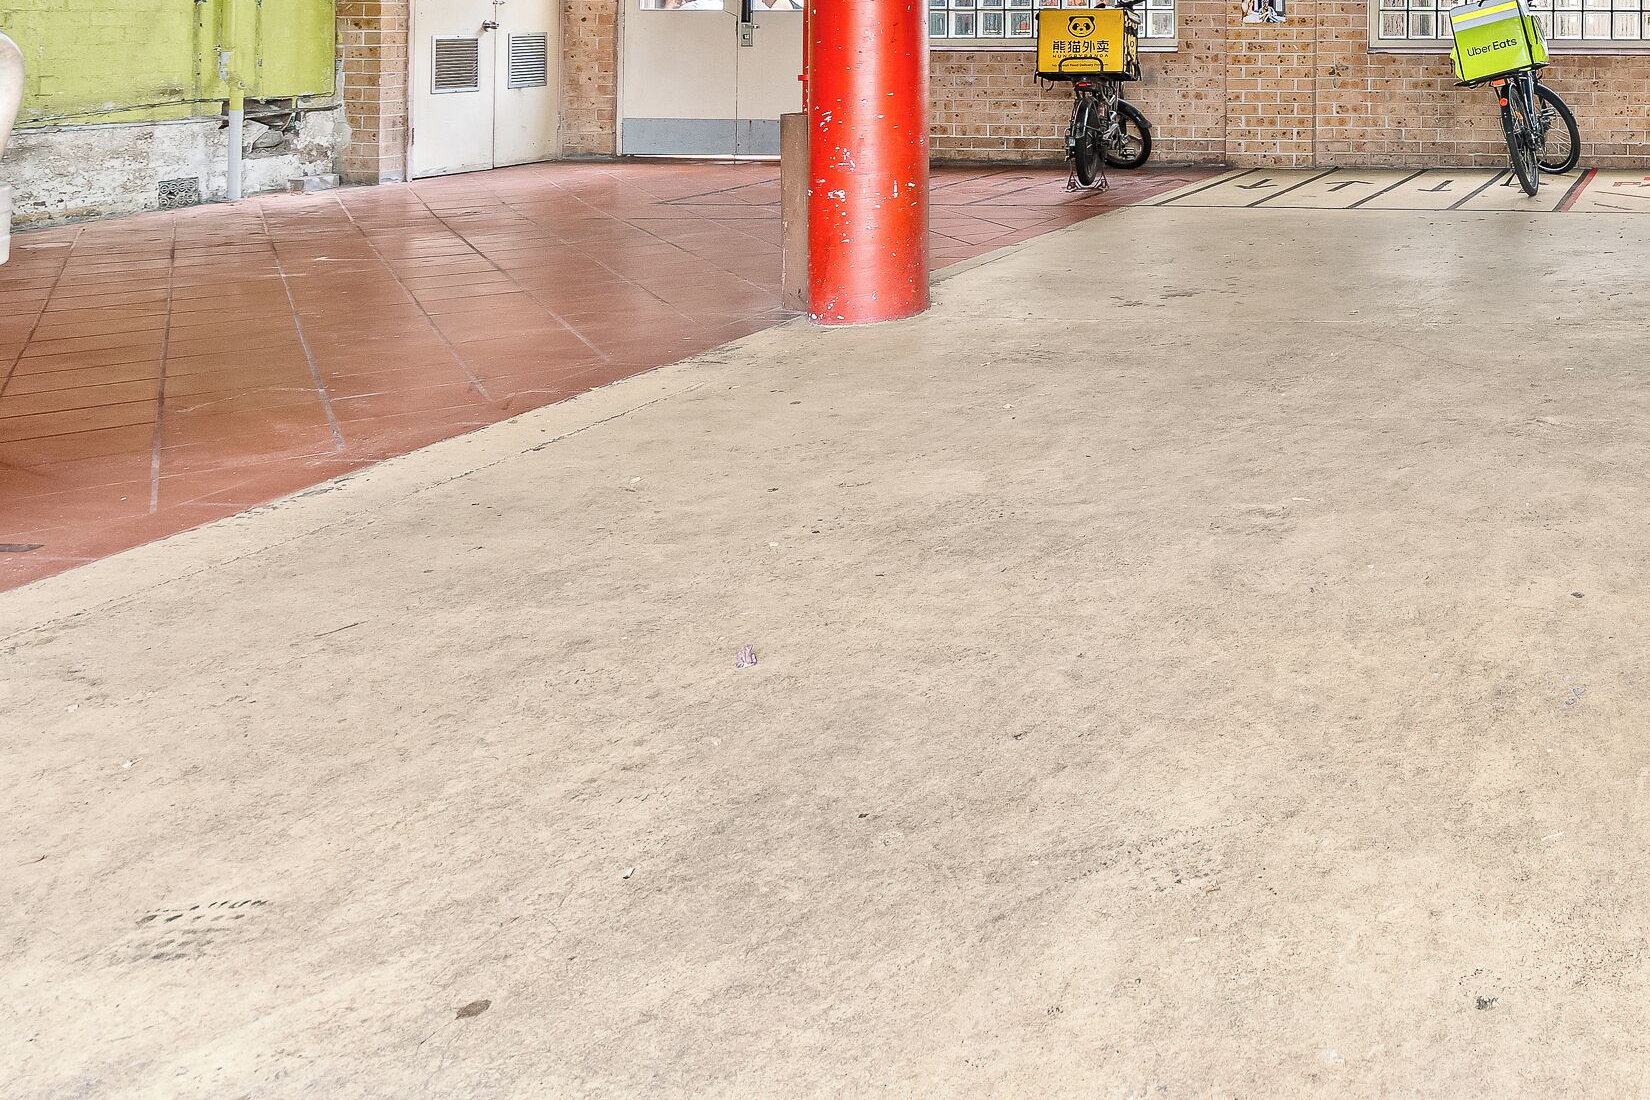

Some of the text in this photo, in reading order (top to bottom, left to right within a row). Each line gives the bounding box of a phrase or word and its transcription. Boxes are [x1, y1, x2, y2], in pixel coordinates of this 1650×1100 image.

[1053, 40, 1109, 53] 熊猫外卖
[1466, 38, 1517, 57] Uber Eats
